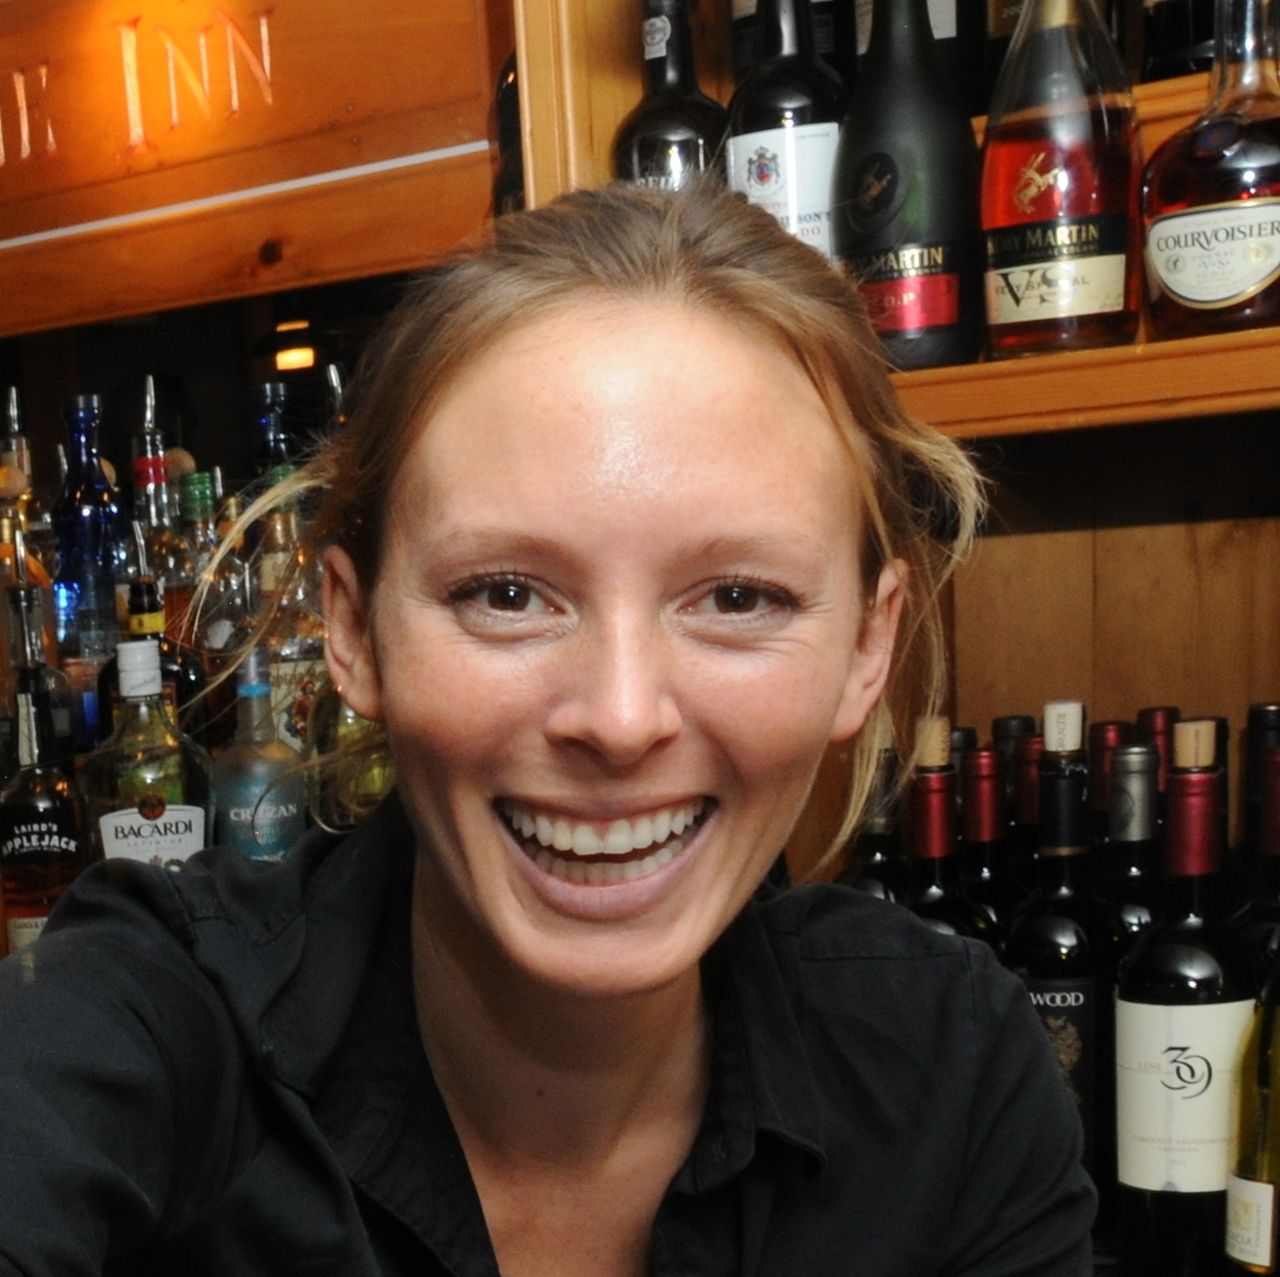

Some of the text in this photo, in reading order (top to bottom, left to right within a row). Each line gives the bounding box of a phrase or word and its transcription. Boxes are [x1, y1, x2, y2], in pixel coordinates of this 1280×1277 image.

[118, 8, 276, 154] INN
[1026, 222, 1100, 248] MARTIN
[1156, 220, 1280, 253] COURVOISIER
[114, 820, 194, 840] BACARDI
[1161, 1045, 1213, 1100] 39
